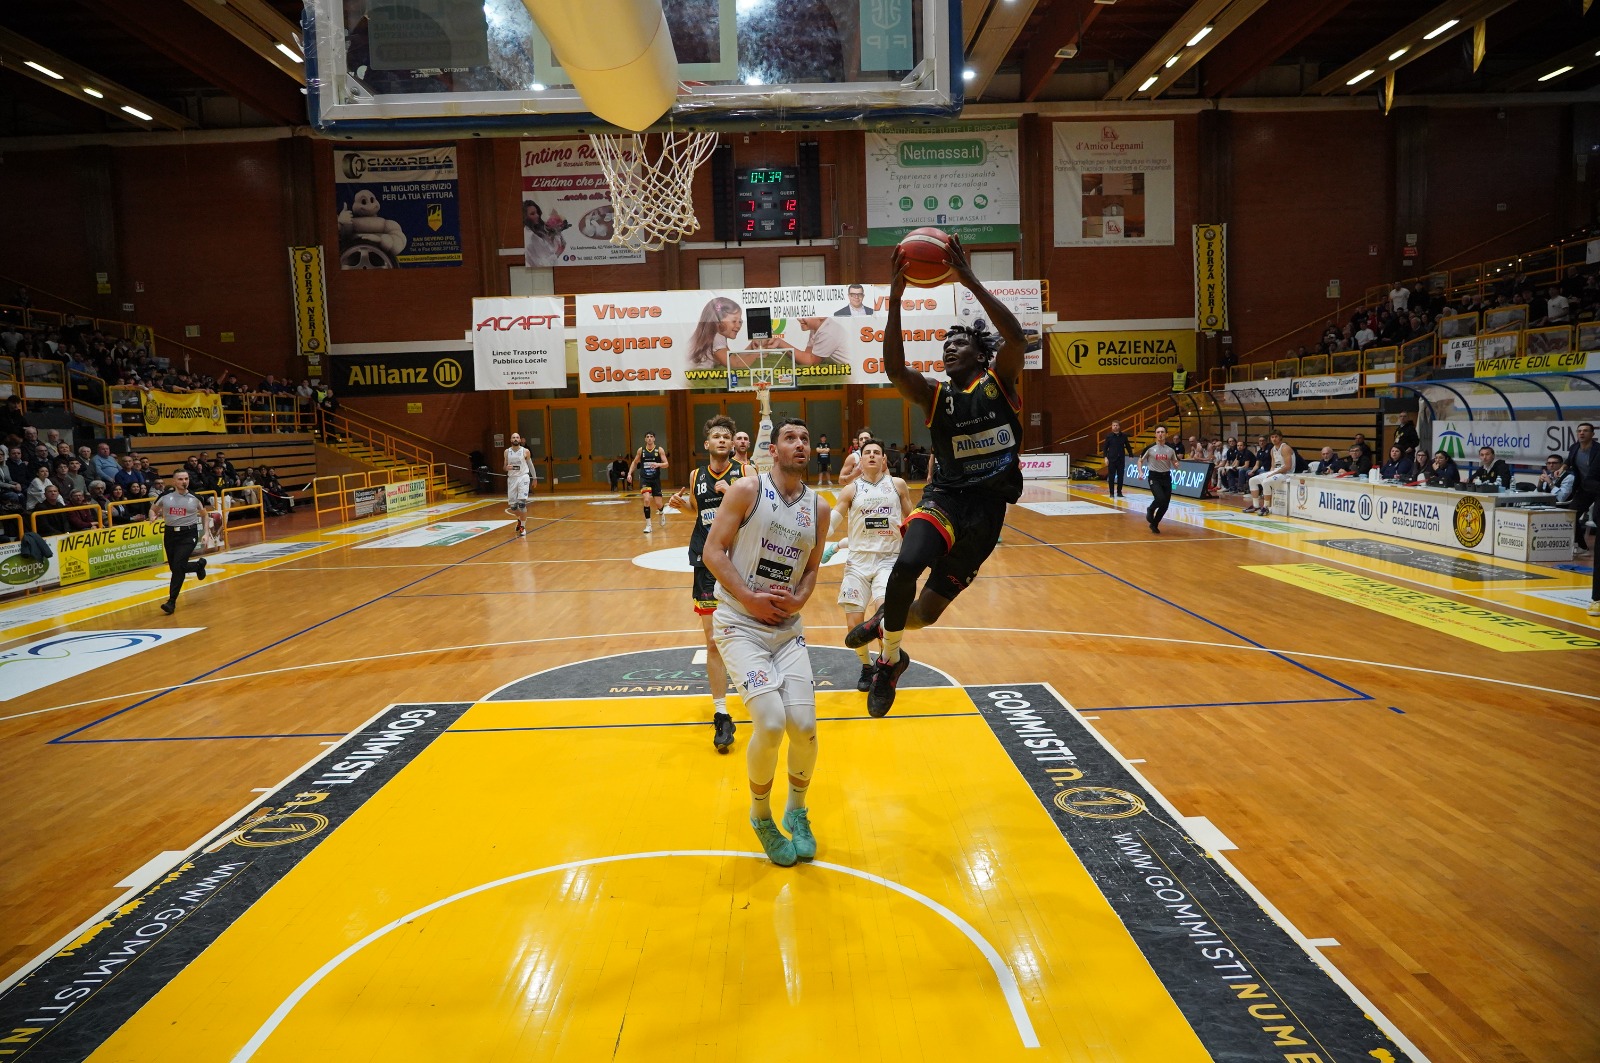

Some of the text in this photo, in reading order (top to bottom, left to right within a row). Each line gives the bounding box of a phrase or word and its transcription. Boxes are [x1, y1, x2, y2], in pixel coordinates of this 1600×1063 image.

[903, 144, 980, 160] Netmassa.it
[1076, 140, 1144, 152] d'Amico Legnami
[367, 155, 453, 167] CIAVARELLA
[524, 147, 573, 168] Intimo
[390, 184, 420, 192] MIGLIOR
[421, 182, 452, 191] SERVIZIO
[532, 177, 594, 188] L'intimo che
[950, 180, 988, 192] tecnologia
[421, 191, 454, 200] VETTURA
[786, 199, 797, 210] 12
[747, 219, 755, 231] 2
[788, 218, 796, 230] 2
[1206, 242, 1215, 279] FORZA
[304, 264, 315, 303] FORZA
[742, 291, 768, 304] FEDERICO
[774, 290, 785, 303] QUA
[790, 290, 802, 302] VIVE
[802, 289, 816, 302] CON
[816, 289, 826, 301] GLI
[1206, 283, 1215, 314] NERI
[592, 295, 937, 319] Vivere Viere
[773, 304, 816, 318] RIP ANIMA BELLA
[306, 306, 317, 337] NERI
[476, 314, 560, 331] ACAPT
[584, 326, 947, 354] Sognare Sonare
[1097, 338, 1177, 355] PAZIENZA
[492, 356, 547, 365] Pubblico Locale
[512, 348, 547, 357] Trasporto
[1097, 353, 1178, 366] assicurazioni
[588, 357, 946, 383] Giocare Gicare
[1475, 352, 1587, 372] INFANTE EDIL CEM
[347, 364, 429, 386] Allianz
[945, 395, 954, 415] 3
[956, 436, 996, 452] Allianz
[1466, 432, 1530, 449] Autorekord
[970, 455, 1011, 471] euronics
[1185, 471, 1205, 488] LNP
[696, 482, 708, 495] 18
[764, 488, 775, 500] 18
[1318, 491, 1356, 514] Allianz
[1391, 500, 1440, 521] PAZIENZA
[1455, 496, 1484, 515] CESTISTICA
[770, 520, 802, 538] FARMACIA
[1391, 515, 1441, 533] assicurazioni
[59, 520, 166, 553] INFANTE EDIL CE
[1500, 537, 1570, 549] 800-090324 800-090324
[88, 554, 116, 566] EDILIZIA
[115, 543, 163, 560] ECOSOSTENIBILE
[1296, 563, 1600, 648] VIVAI PIANTE PADRE PIO
[608, 684, 689, 693] MARMI
[987, 689, 1078, 764] GOMMISTI
[312, 707, 438, 786] GOMMISTI
